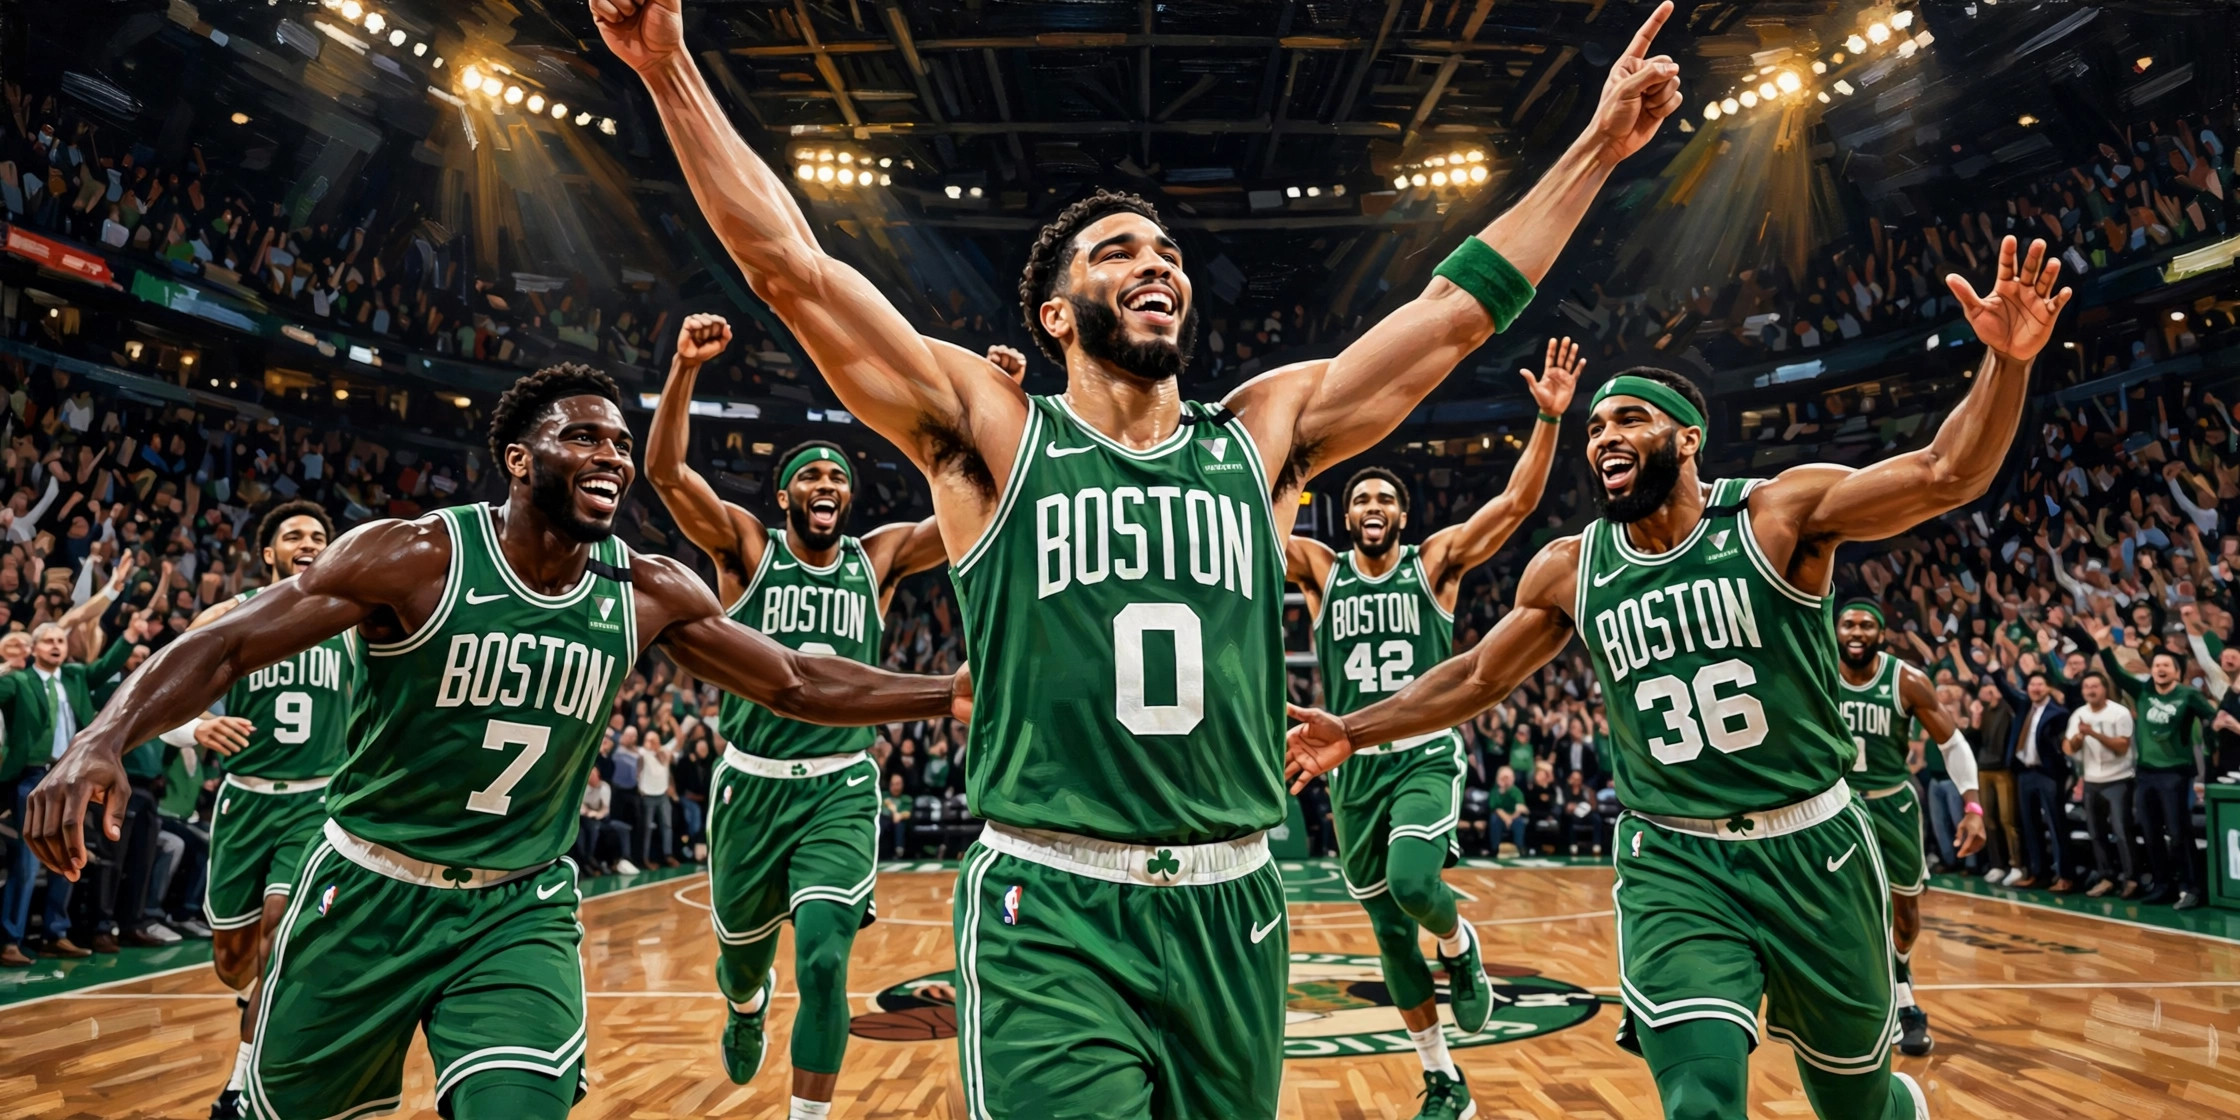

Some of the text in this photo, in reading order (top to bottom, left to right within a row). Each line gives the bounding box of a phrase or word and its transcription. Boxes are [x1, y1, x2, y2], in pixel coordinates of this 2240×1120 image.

[1036, 486, 1253, 600] BOSTON
[762, 584, 866, 643] BOSTON
[1332, 592, 1420, 641] BOSTON
[1595, 578, 1763, 683] BOSTON
[435, 632, 615, 724] BOSTON
[1113, 602, 1204, 735] 0
[1344, 639, 1414, 693] 42
[1634, 658, 1769, 765] 36
[273, 691, 313, 744] 9
[1840, 701, 1891, 737] STON
[465, 719, 551, 816] 7
